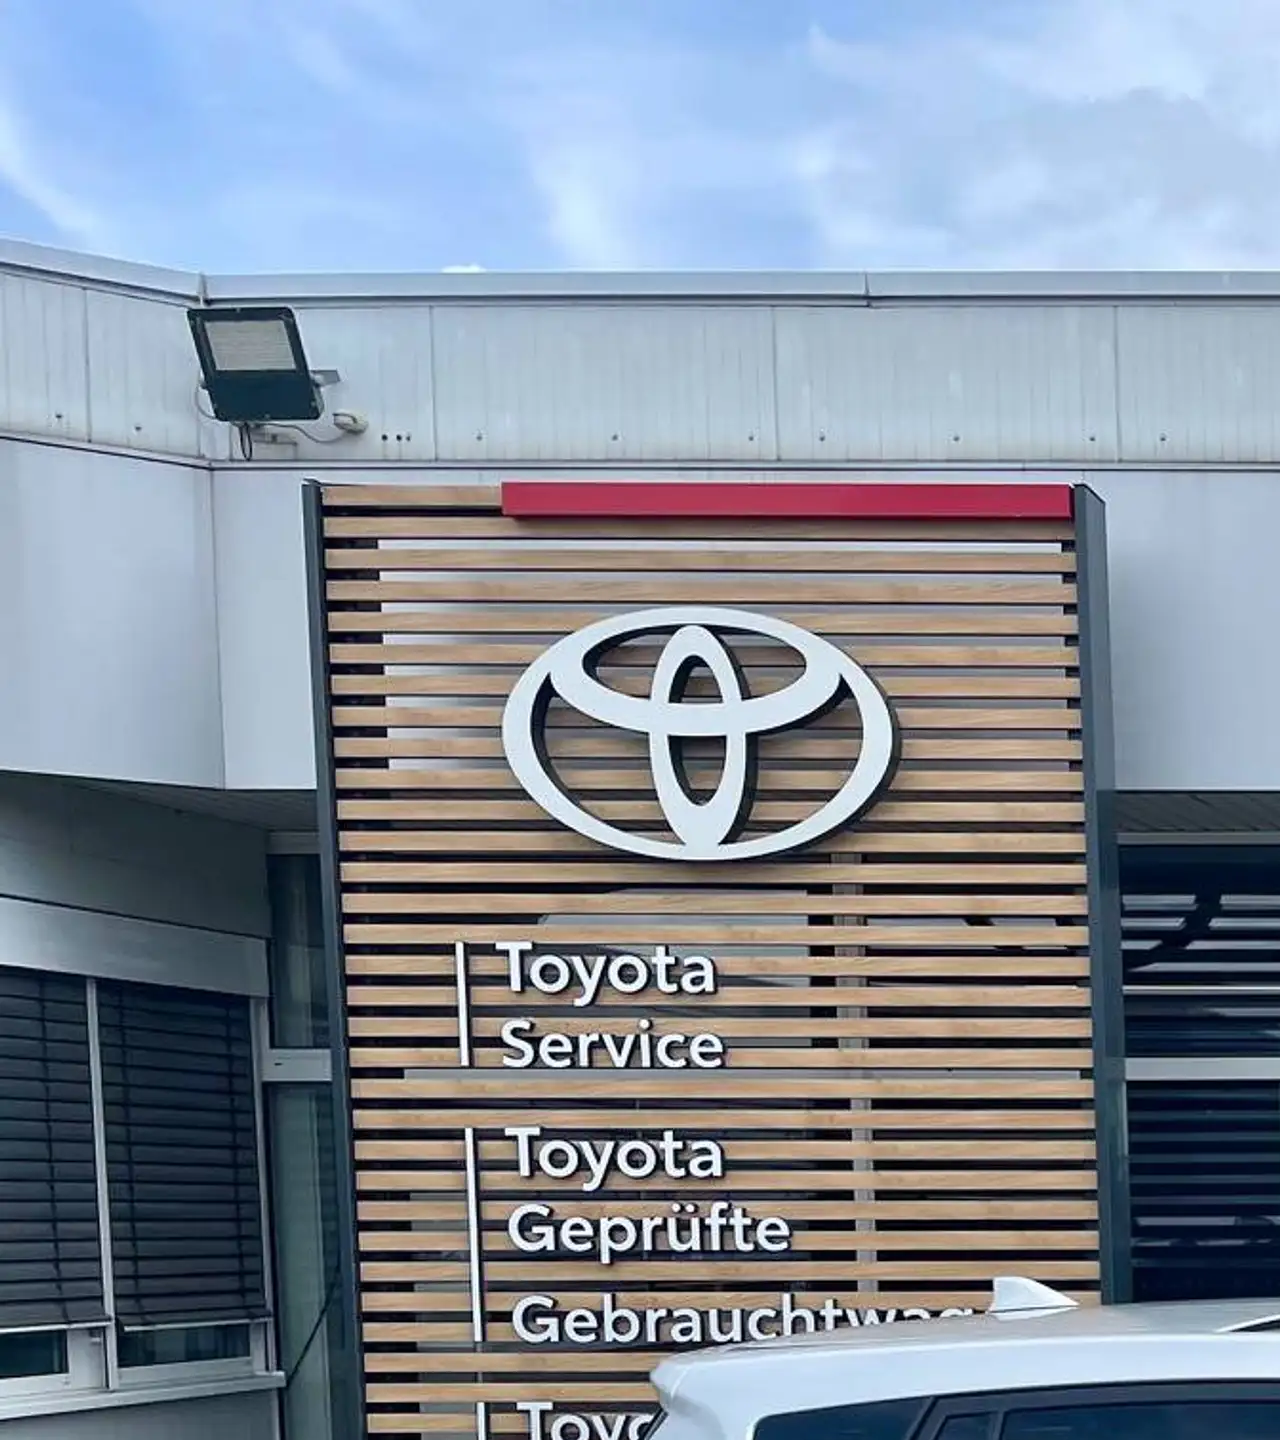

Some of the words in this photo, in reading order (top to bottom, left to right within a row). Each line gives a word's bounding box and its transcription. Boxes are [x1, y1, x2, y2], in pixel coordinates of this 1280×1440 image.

[494, 940, 718, 1008] Toyota
[500, 1017, 726, 1069] Service
[504, 1125, 725, 1193] Toyota
[507, 1201, 792, 1265] Geprüfte
[511, 1292, 975, 1345] Gebraucht
